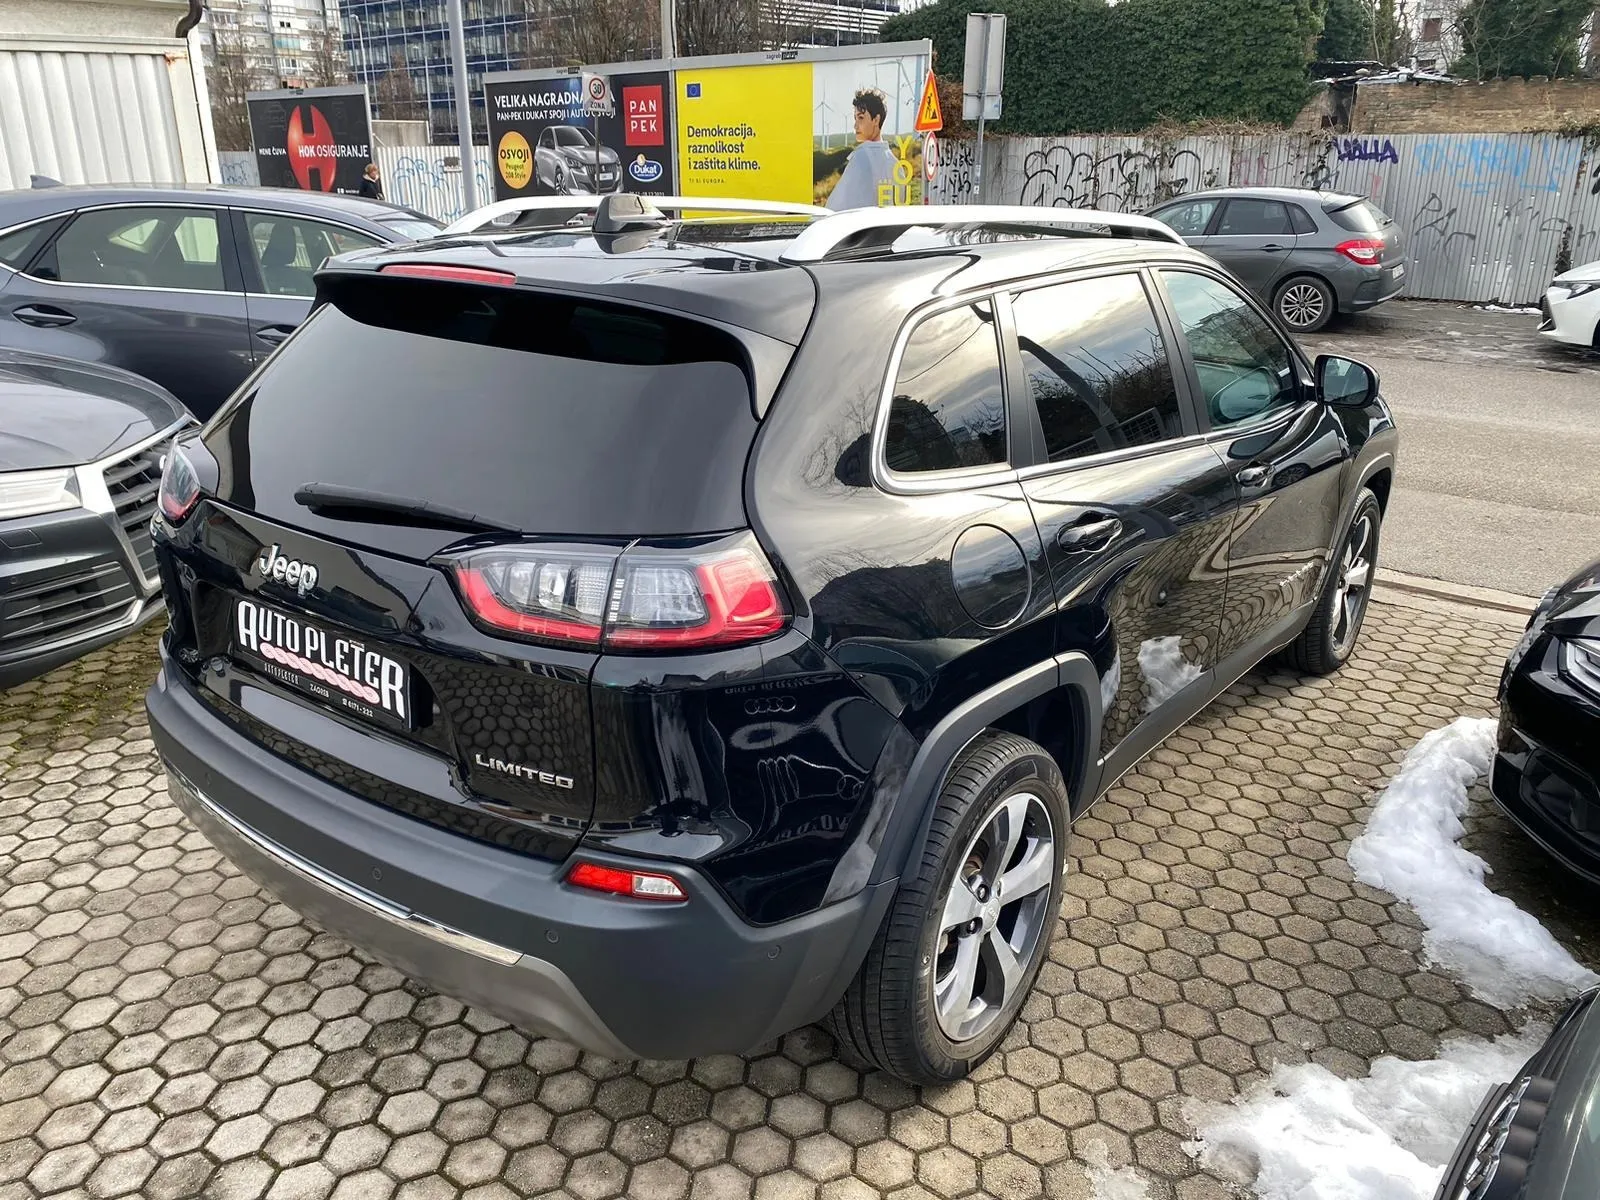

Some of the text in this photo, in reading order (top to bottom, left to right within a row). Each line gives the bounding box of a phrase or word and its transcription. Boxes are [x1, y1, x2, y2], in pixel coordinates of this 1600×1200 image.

[592, 83, 602, 94] 30
[494, 94, 528, 108] VELIKA
[590, 101, 606, 110] ZONA
[630, 99, 657, 113] PAN
[496, 111, 522, 121] PAN-PEK
[526, 109, 549, 121] DUKAT
[549, 108, 566, 120] SPOJI
[570, 108, 591, 118] AUTO
[631, 119, 657, 133] PEK
[687, 123, 756, 140] Demokracija,
[272, 146, 287, 156] ČUVA
[298, 144, 370, 158] HOK OSIGURANJE
[688, 140, 744, 154] raznolikost
[500, 149, 529, 163] OSVOJI
[693, 156, 727, 170] zaštita
[728, 156, 761, 170] klime.
[634, 164, 658, 174] Dukat
[259, 543, 319, 596] Jeep
[238, 600, 405, 719] AUTO PLETER
[475, 753, 575, 789] LIMITED
